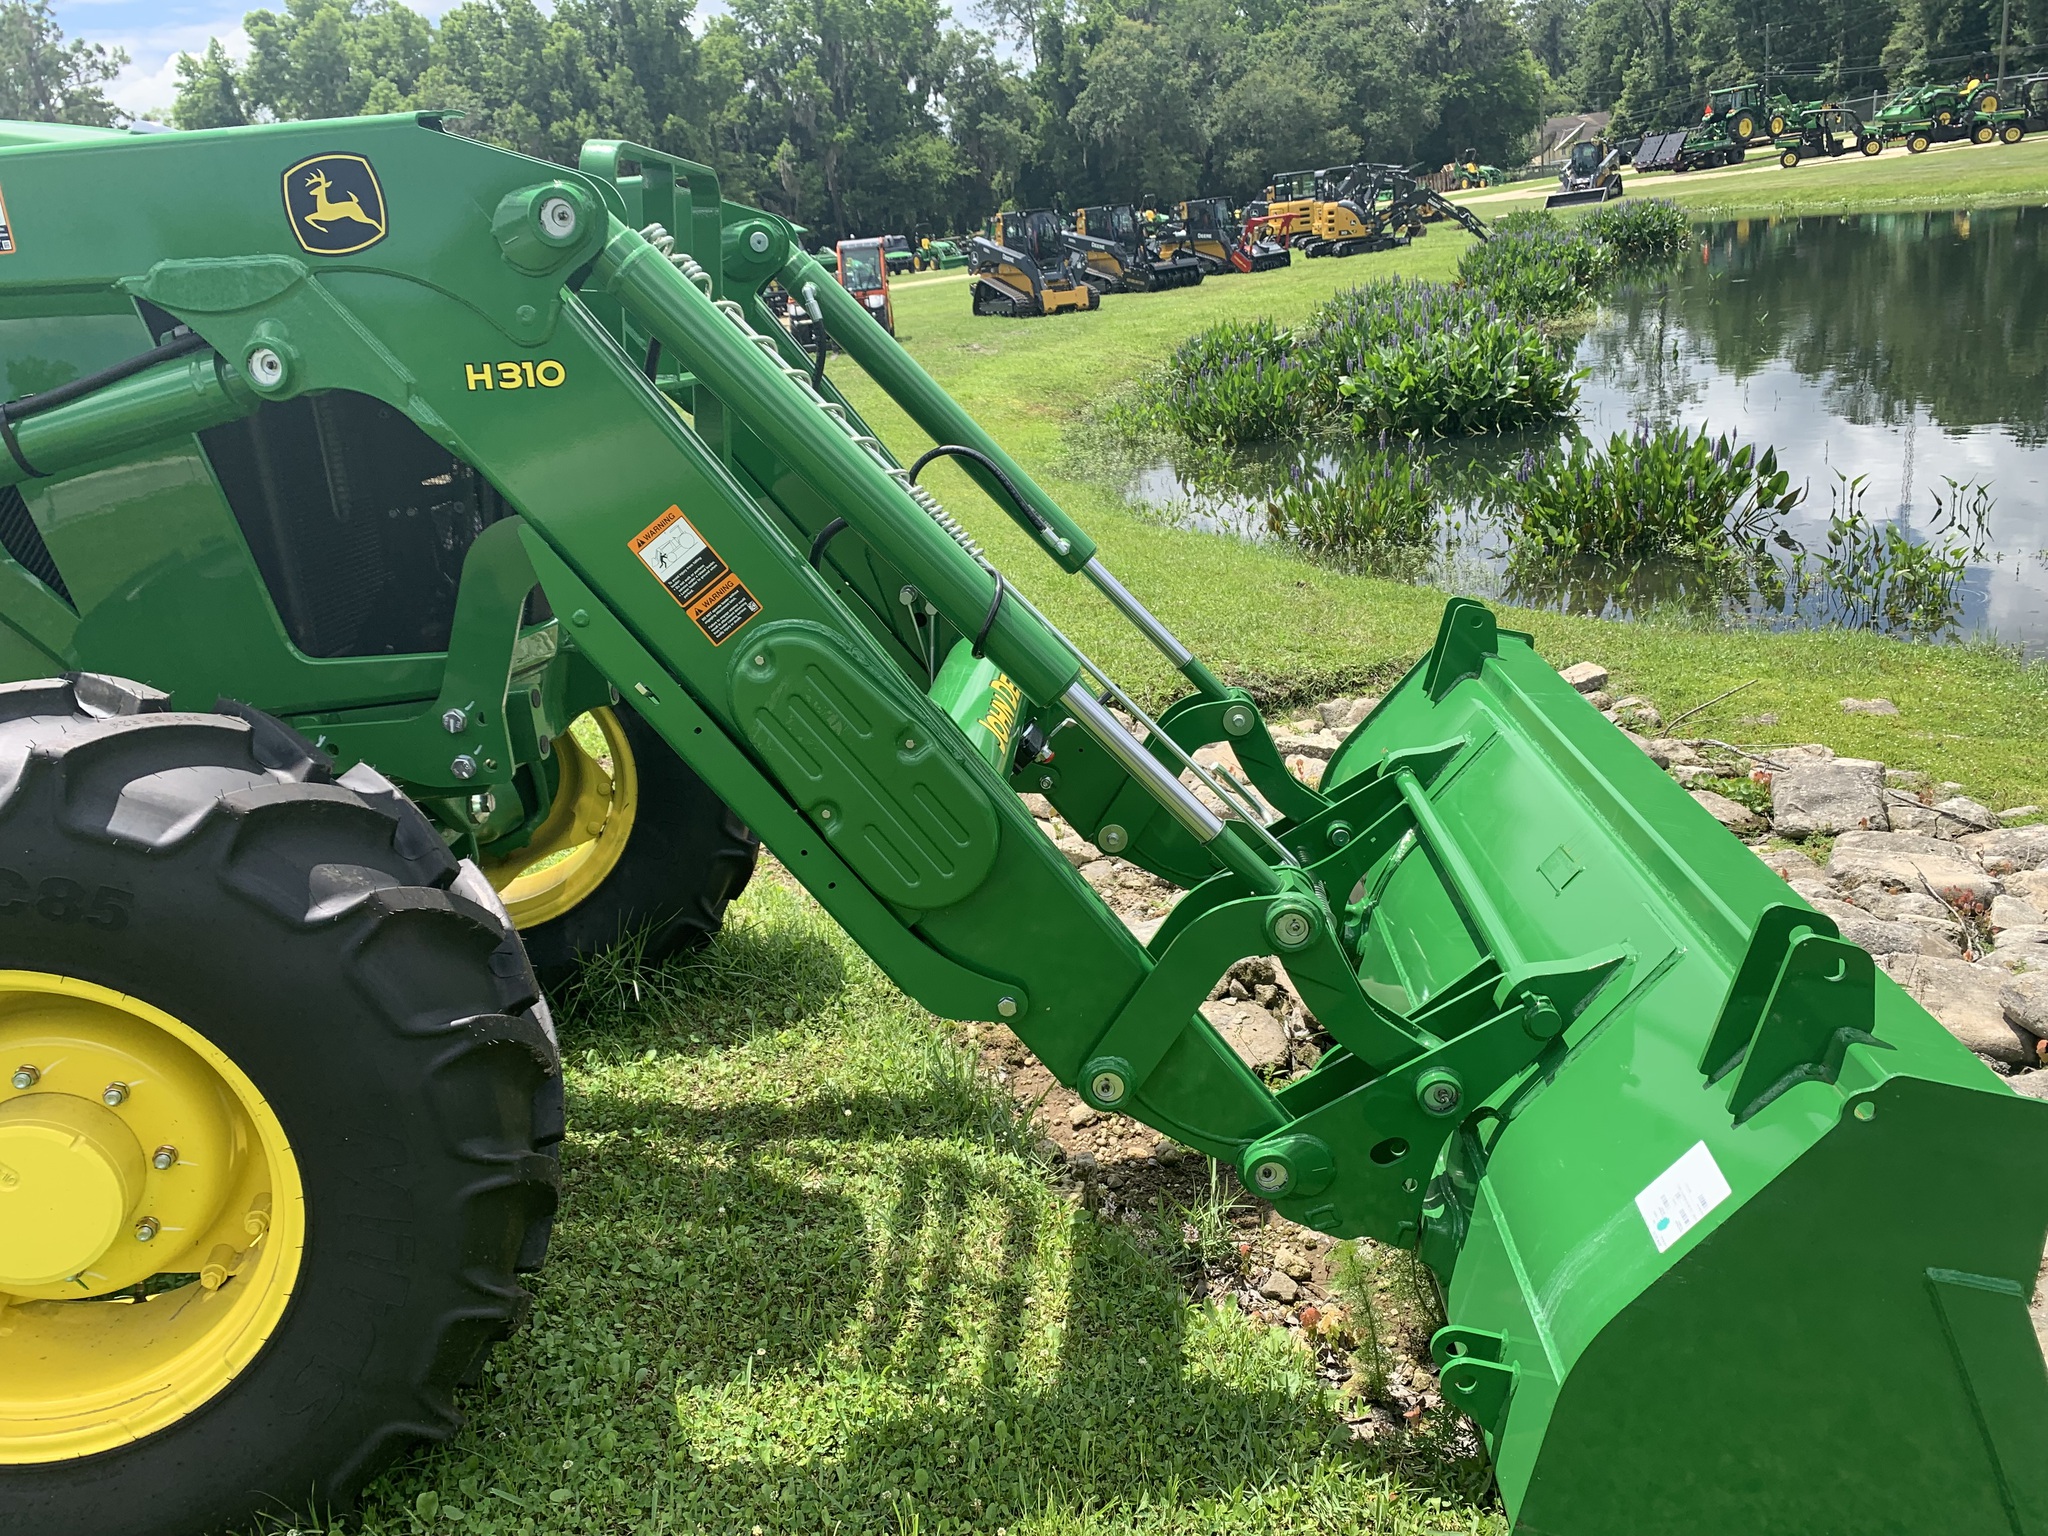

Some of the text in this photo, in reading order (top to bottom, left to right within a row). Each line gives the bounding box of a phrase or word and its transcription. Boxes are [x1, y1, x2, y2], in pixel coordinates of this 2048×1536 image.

[642, 512, 675, 541] WARNING
[701, 581, 734, 607] WARNING
[977, 692, 1014, 756] JOHN
